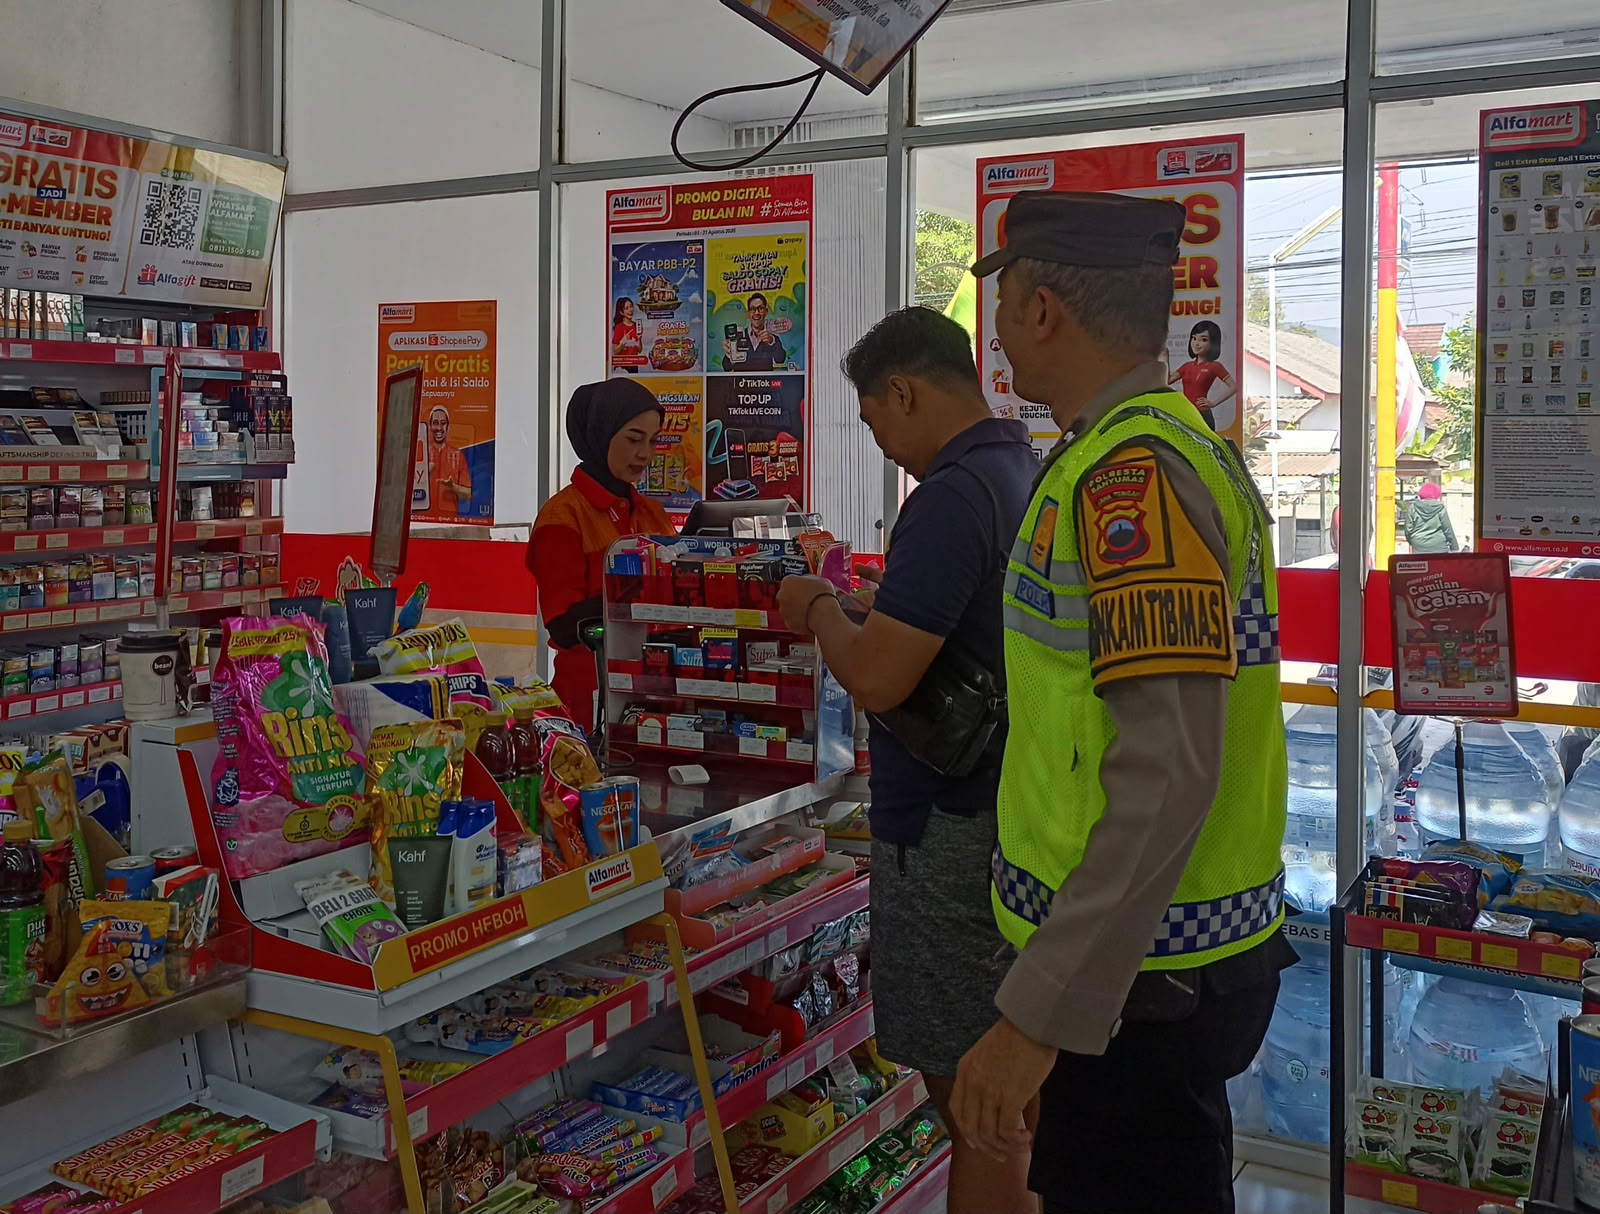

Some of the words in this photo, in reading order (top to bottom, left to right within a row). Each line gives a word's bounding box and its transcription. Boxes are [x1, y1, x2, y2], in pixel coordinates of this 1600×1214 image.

[1491, 112, 1573, 131] Alfamart
[0, 151, 118, 199] GRATIS
[987, 164, 1049, 181] Alfamart
[40, 188, 63, 198] JADI
[676, 190, 719, 205] PROMO
[723, 187, 771, 201] DIGITAL
[613, 194, 663, 209] Alfamart
[692, 207, 734, 221] BULAN
[737, 205, 754, 218] INI
[14, 221, 61, 236] BANYAK
[62, 226, 112, 242] UNTUNG!
[619, 260, 655, 272] BAYAR
[657, 258, 696, 270] PBB-P2
[157, 273, 196, 287] Alfagift
[728, 277, 783, 293] GRATIS!
[382, 307, 412, 316] Alfamart
[394, 336, 428, 346] APLIKASI
[439, 335, 482, 348] ShopeePay
[434, 354, 490, 374] Gratis
[450, 377, 460, 388] Isi
[463, 377, 490, 388] Saldo
[746, 379, 770, 388] TikTok
[738, 394, 757, 405] TOP
[758, 394, 772, 404] UP
[749, 407, 764, 415] LIVE
[764, 407, 781, 415] COIN
[747, 443, 768, 453] GRATIS
[1088, 468, 1146, 488] POLRESTA
[1091, 476, 1145, 494] BANYUMAS
[758, 543, 780, 551] RAND
[1505, 544, 1568, 553] www.alfamart.co.id
[1409, 581, 1460, 595] Cemilan
[355, 597, 377, 608] Kahf
[1416, 592, 1484, 611] Ceban
[261, 707, 353, 758] Rins
[287, 758, 322, 775] ANTI
[310, 771, 351, 786] SIGNATUR
[383, 787, 444, 825] Rins
[398, 850, 426, 863] Kahf
[589, 859, 630, 886] Alfamart
[311, 896, 343, 920] BELI
[340, 894, 351, 907] 2
[1280, 923, 1319, 939] EBAS
[410, 926, 469, 958] PROMO
[60, 1126, 154, 1170] SILVERQUEEN
[92, 1134, 186, 1179] SILVERQUEEN
[120, 1137, 214, 1183] SILVERQUEEN
